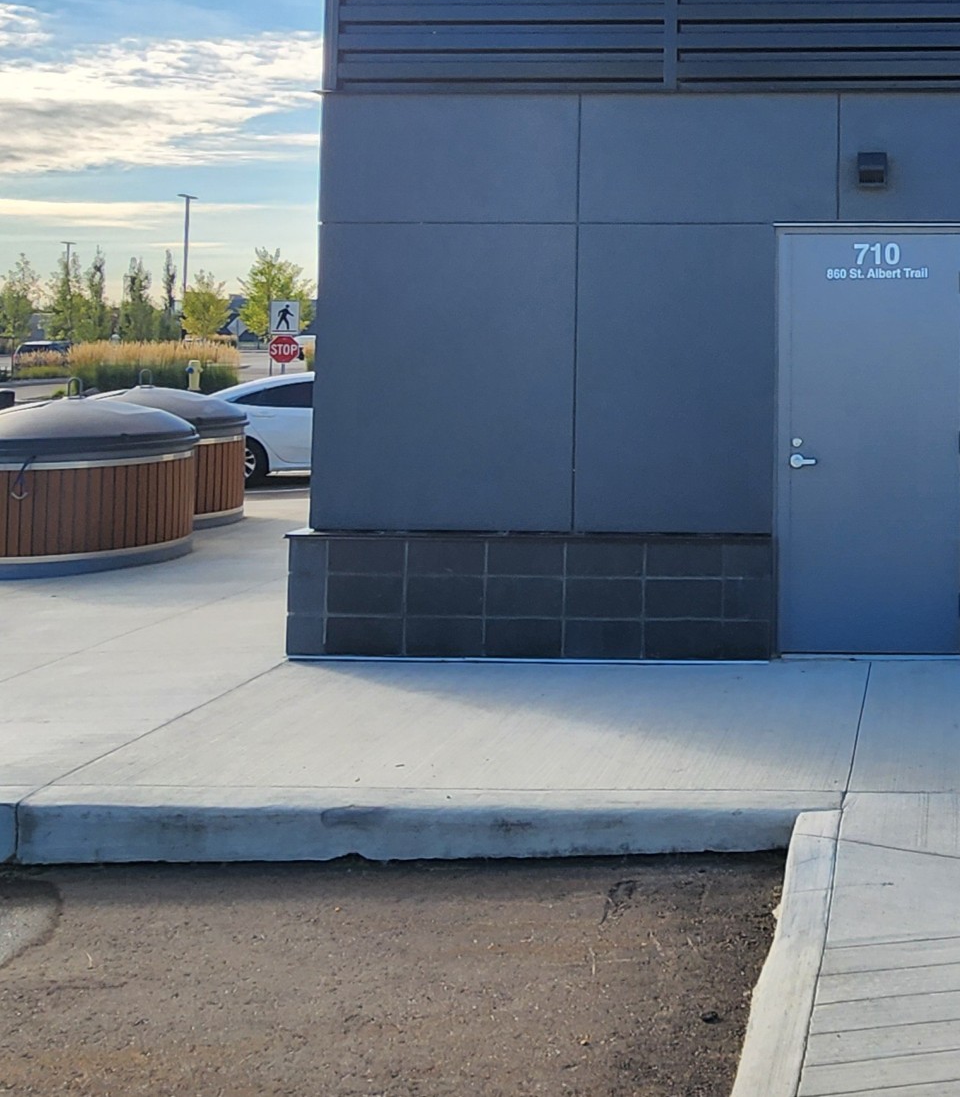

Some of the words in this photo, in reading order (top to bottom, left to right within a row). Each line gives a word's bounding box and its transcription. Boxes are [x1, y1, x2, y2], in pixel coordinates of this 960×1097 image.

[853, 243, 900, 265] 710
[826, 268, 847, 279] 860
[849, 268, 865, 279] St.
[867, 267, 901, 278] Albert
[903, 267, 928, 278] Trail
[270, 343, 298, 356] STOP
